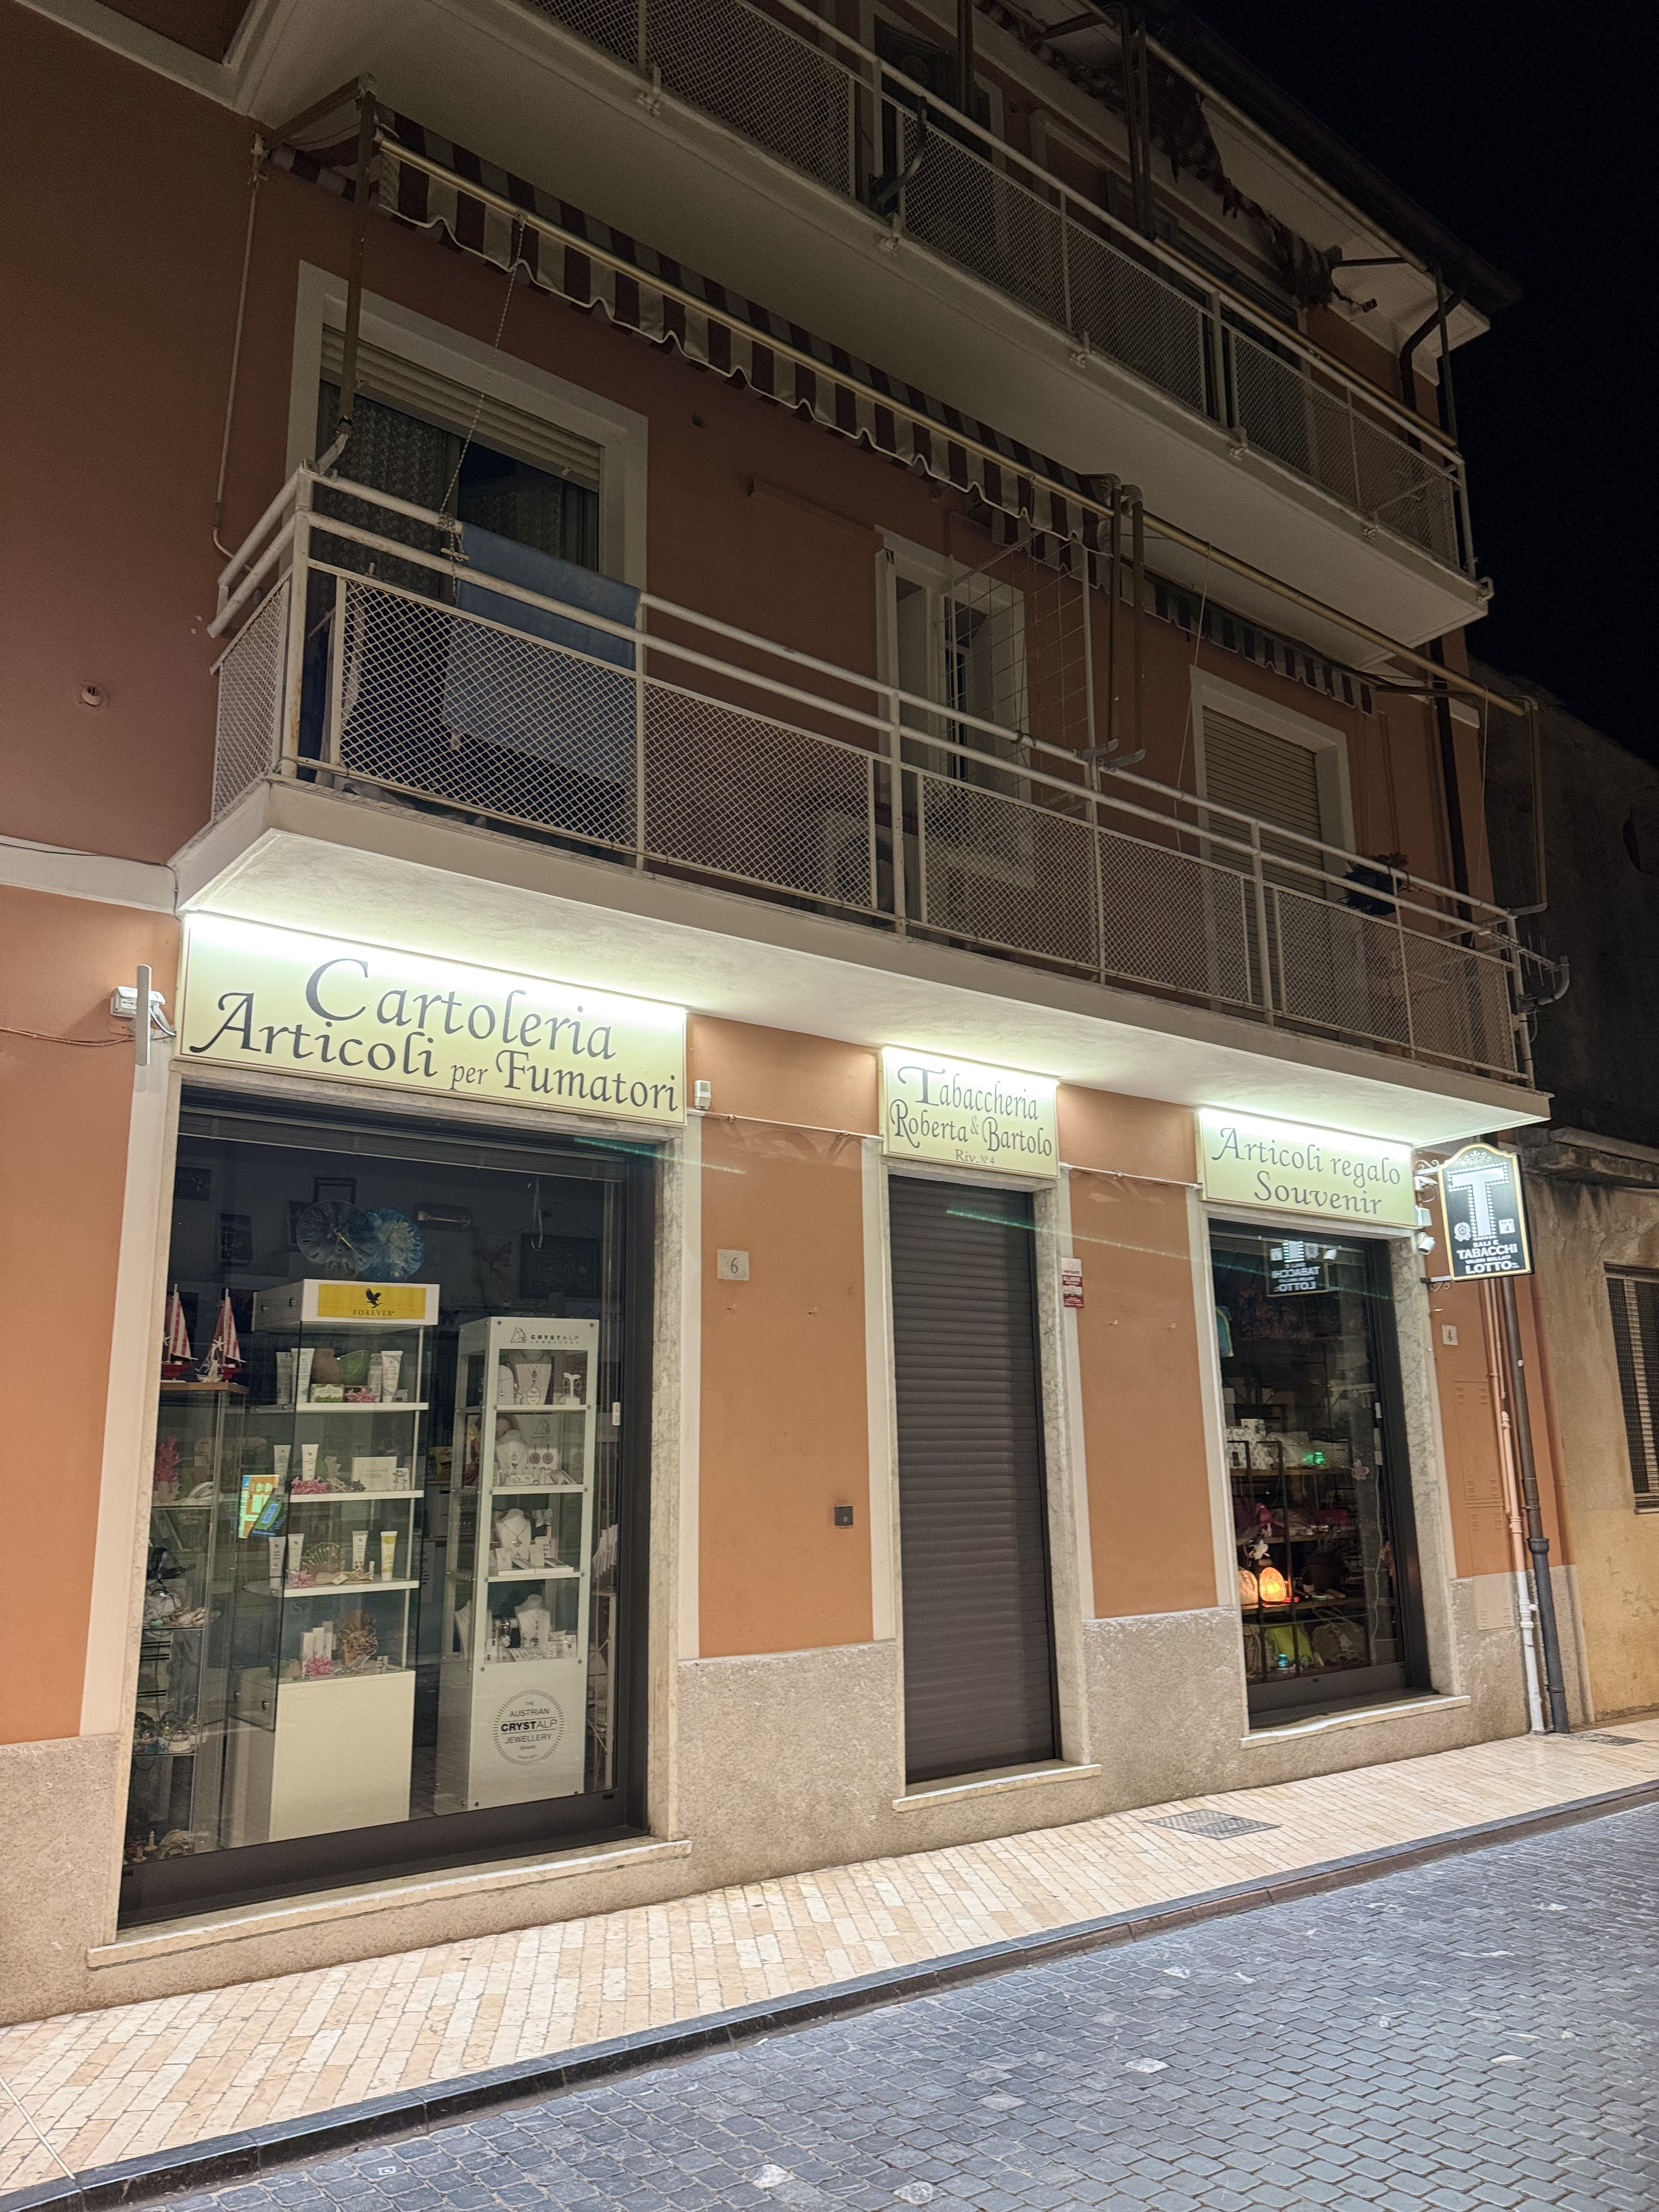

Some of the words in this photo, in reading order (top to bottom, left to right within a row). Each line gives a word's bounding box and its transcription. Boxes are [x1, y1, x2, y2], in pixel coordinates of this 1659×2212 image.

[306, 958, 617, 1061] Cartoleria
[189, 992, 438, 1078] Articoli
[450, 1063, 489, 1091] per
[495, 1049, 679, 1113] Fumatori
[898, 1066, 1039, 1120] Tabaccheria
[890, 1099, 969, 1148] Roberta
[970, 1115, 979, 1135] &
[981, 1116, 1052, 1156] Bartolo
[954, 1149, 979, 1164] Riv.
[1211, 1127, 1324, 1173] Articoli
[1330, 1157, 1401, 1188] regalo
[1254, 1170, 1382, 1215] Souvenir
[1447, 1161, 1509, 1240] T
[730, 1257, 738, 1273] 6
[1456, 1243, 1518, 1260] TABACCHI
[1465, 1260, 1512, 1274] LOTTO
[500, 1719, 558, 1732] CRYSTALP
[509, 1708, 550, 1717] AUSTRIAN
[504, 1733, 552, 1744] JEWELLERY
